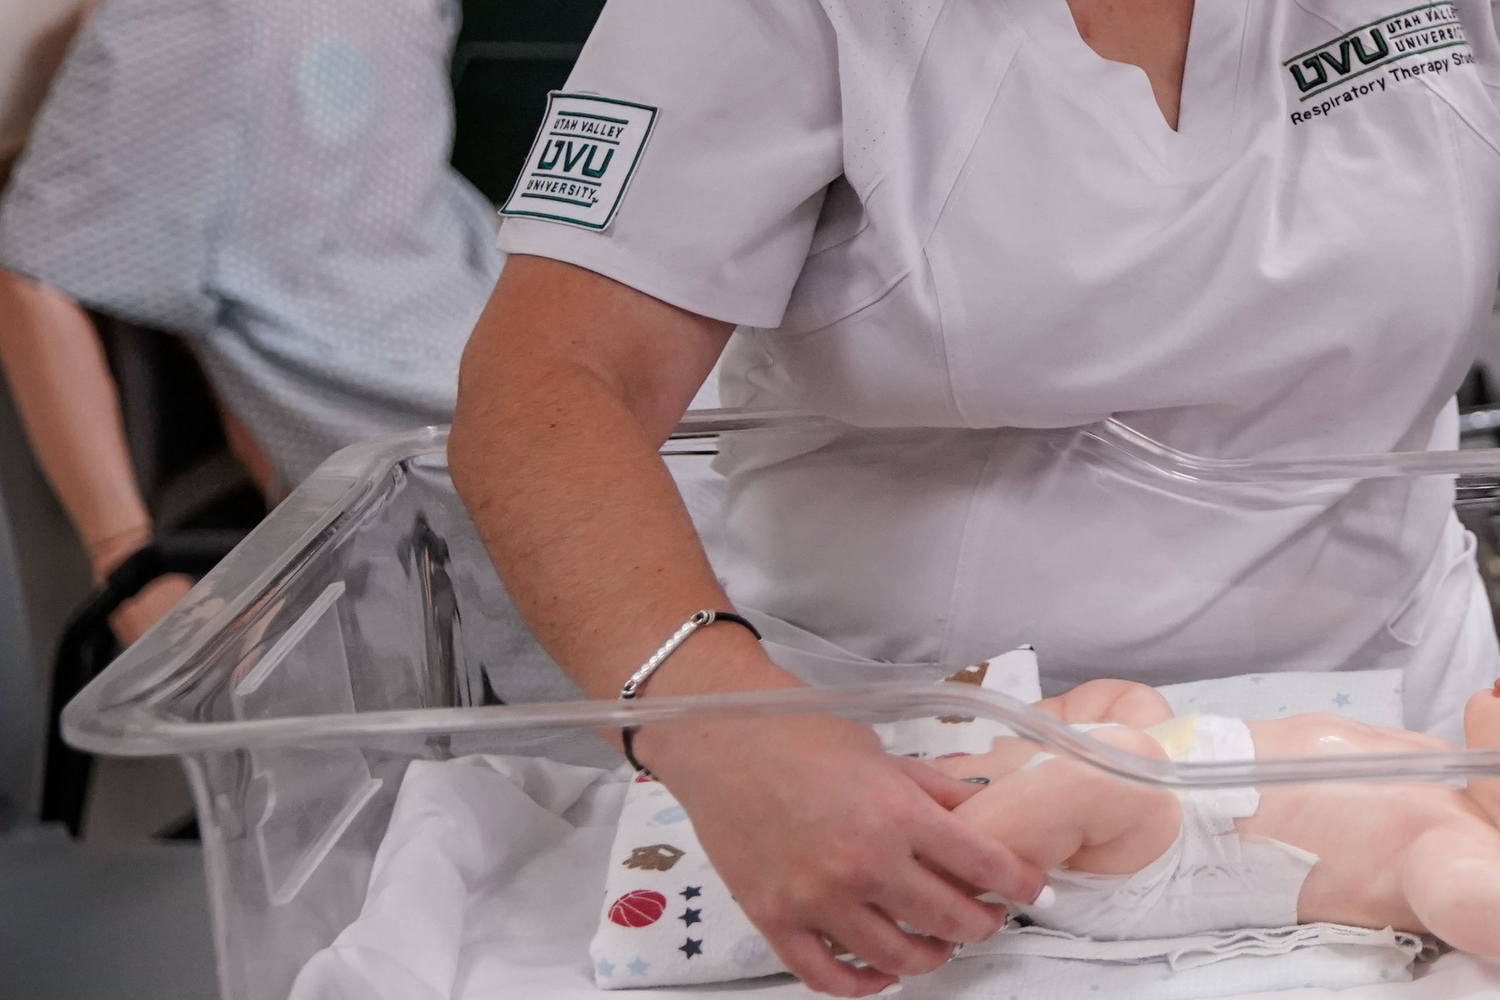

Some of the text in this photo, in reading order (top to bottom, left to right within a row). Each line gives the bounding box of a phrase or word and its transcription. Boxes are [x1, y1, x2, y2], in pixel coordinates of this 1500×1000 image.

[1386, 15, 1421, 34] UTAH
[1289, 28, 1389, 93] UVU
[1290, 77, 1386, 125] Respiratory
[1388, 58, 1449, 82] Therapy
[553, 118, 624, 139] UTAH VALLEY
[537, 139, 615, 178] UVU
[526, 179, 598, 200] UNIVERSITY
